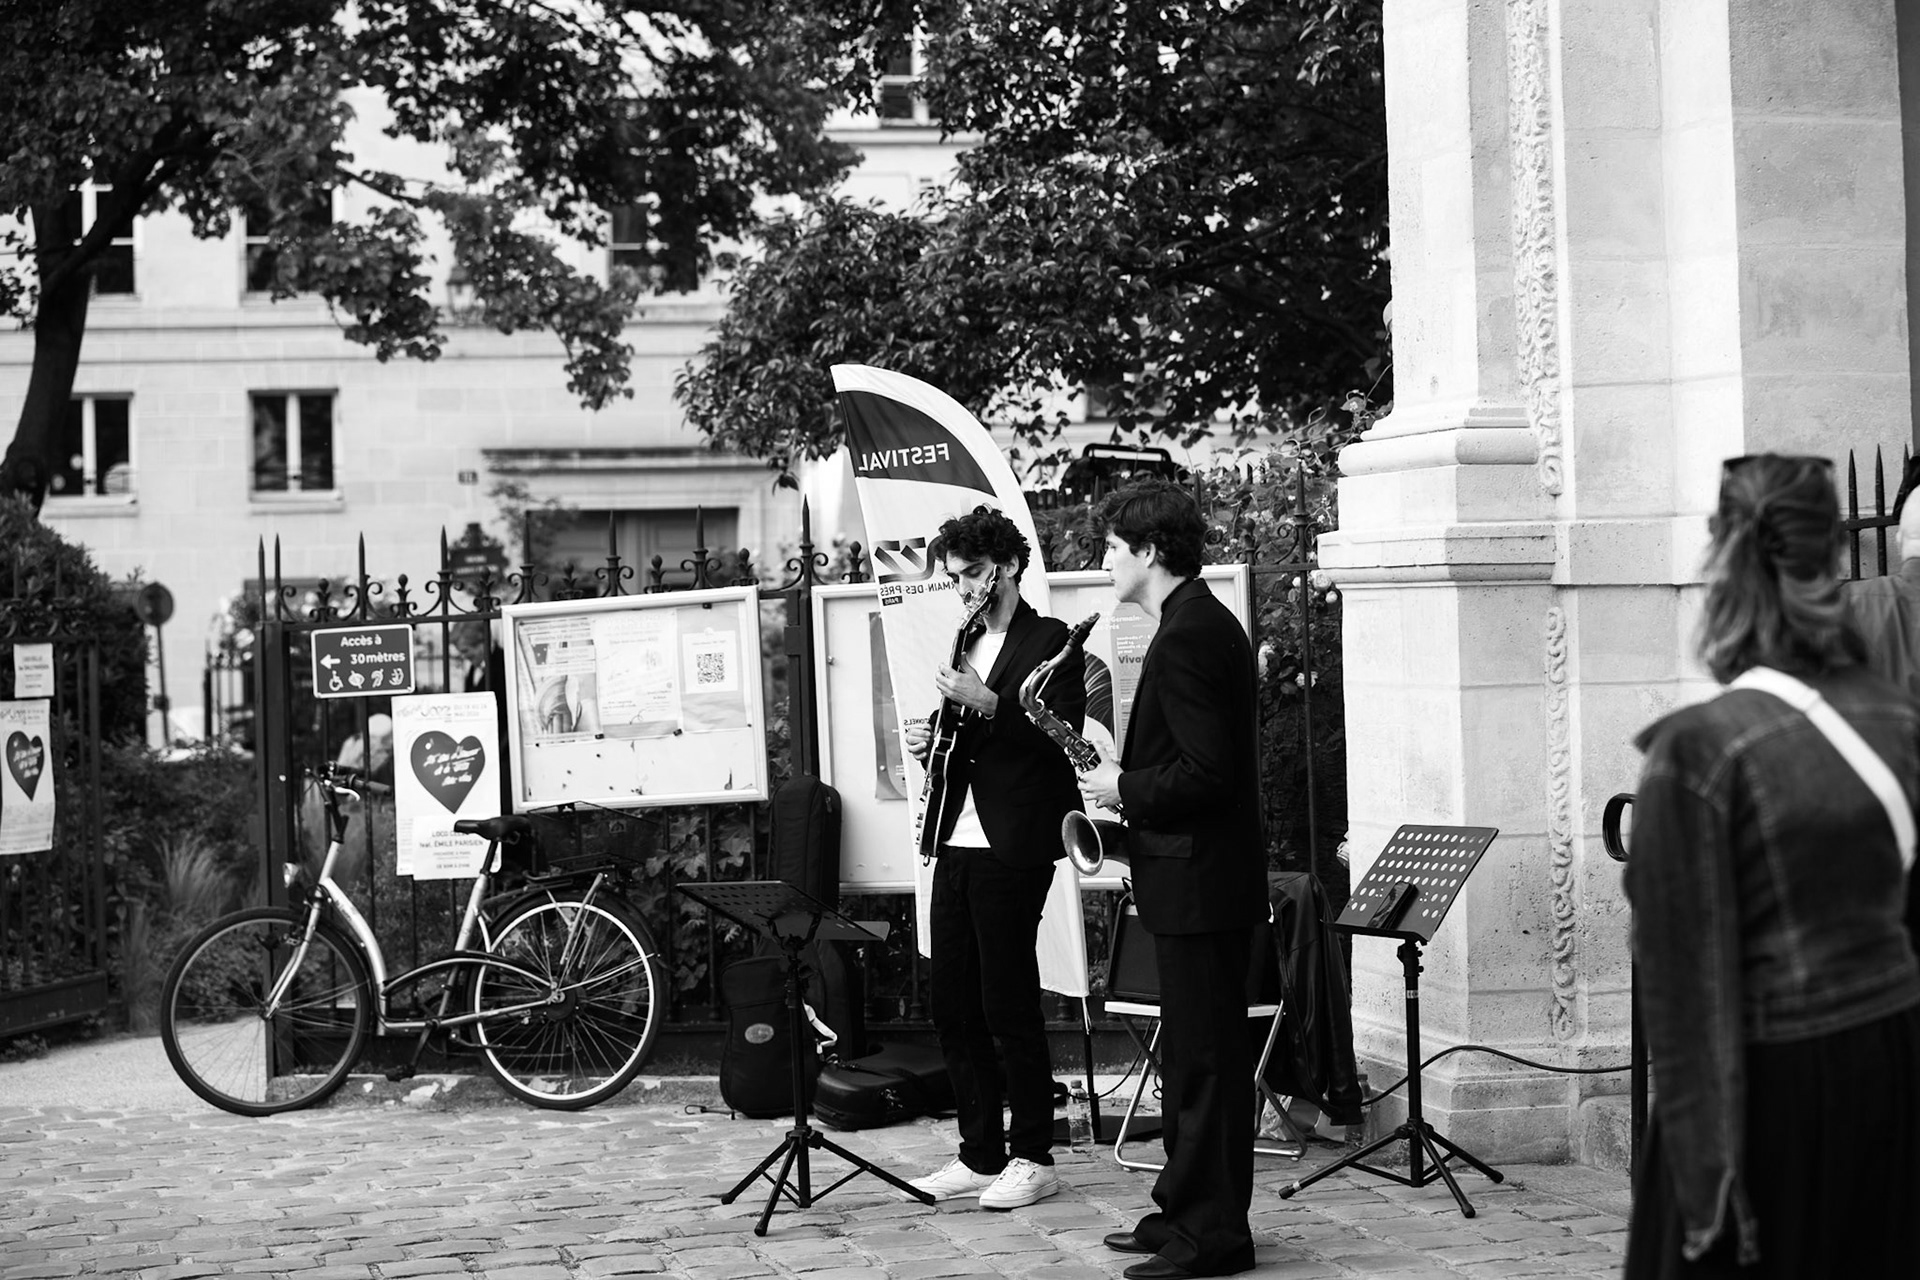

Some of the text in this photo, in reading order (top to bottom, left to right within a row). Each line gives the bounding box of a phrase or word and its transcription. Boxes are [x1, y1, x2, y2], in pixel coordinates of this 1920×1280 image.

[341, 634, 383, 647] Accès à
[455, 839, 484, 847] PARISIEN
